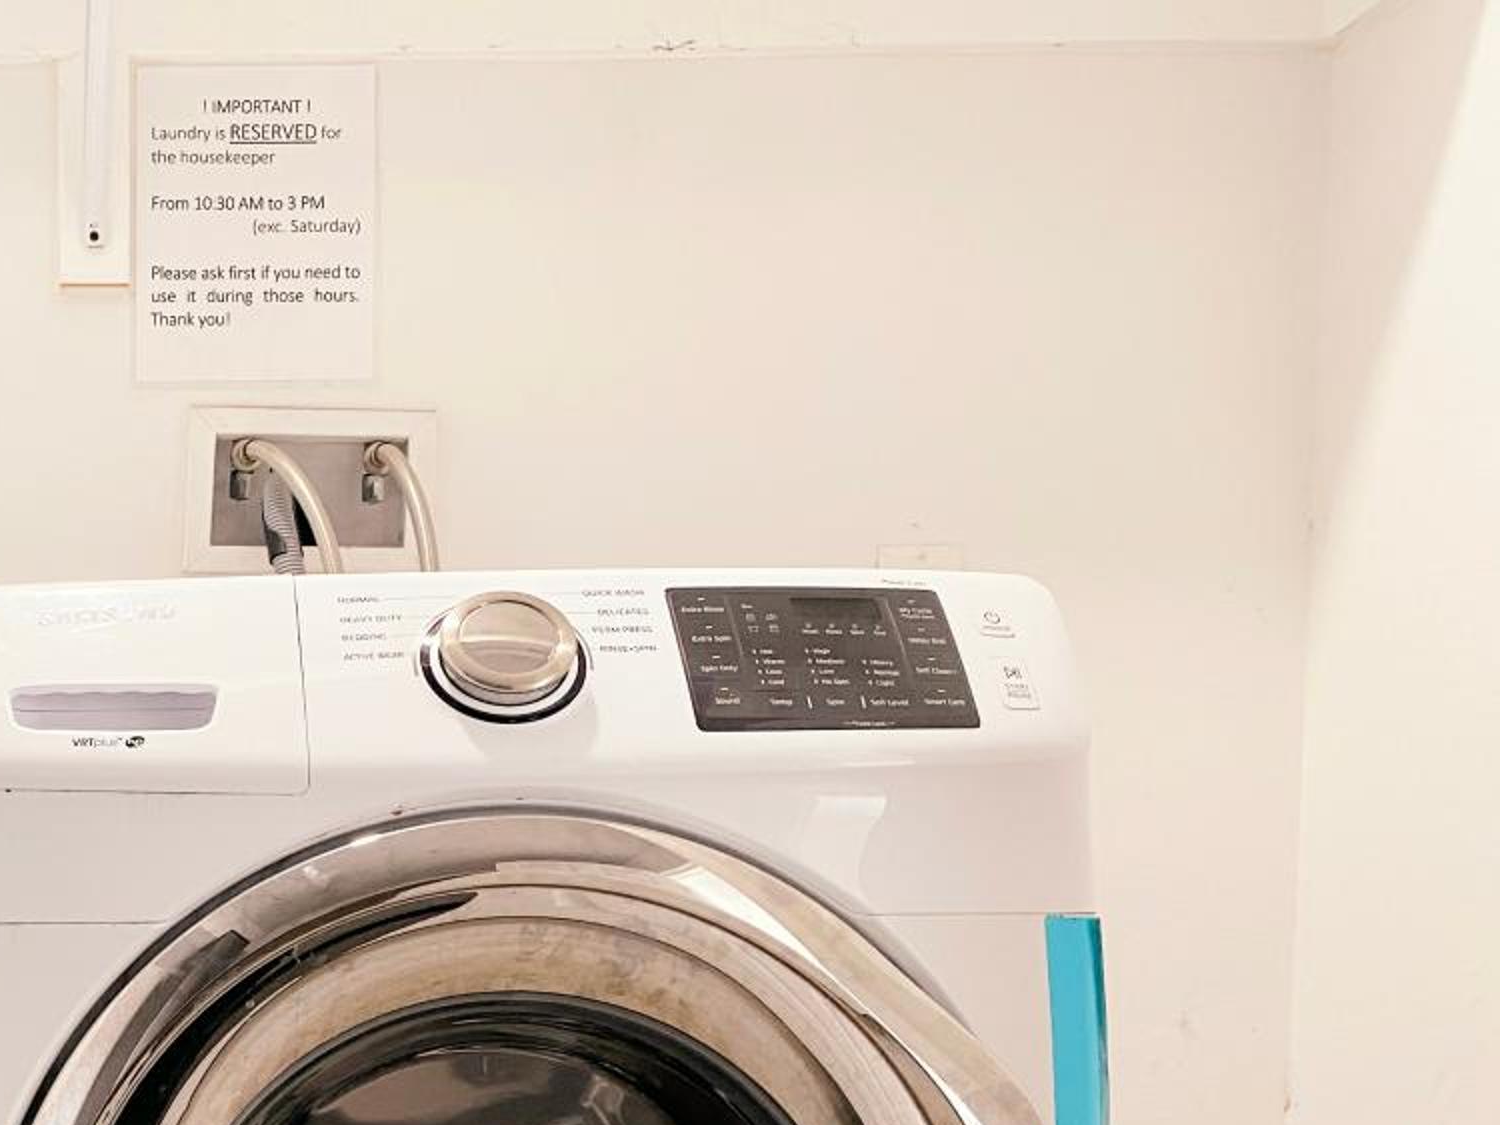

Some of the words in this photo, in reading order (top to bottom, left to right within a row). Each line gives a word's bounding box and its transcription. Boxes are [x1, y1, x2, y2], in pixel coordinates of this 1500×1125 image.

[211, 100, 302, 114] IMPORTANT
[151, 127, 211, 142] Laundry
[215, 127, 226, 140] is
[229, 124, 317, 144] RESERVED
[320, 126, 342, 140] for
[151, 151, 177, 165] the
[180, 150, 276, 167] housekeeper
[151, 197, 190, 211] From
[237, 197, 264, 211] AM
[267, 197, 284, 211] to
[287, 197, 297, 211] 3
[301, 197, 326, 211] PM
[252, 218, 284, 236] (exc.
[290, 219, 362, 236] Saturday)
[151, 266, 198, 281] Please
[201, 266, 223, 280] ask
[229, 265, 256, 280] first
[260, 265, 270, 280] if
[274, 269, 301, 284] you
[305, 265, 342, 280] need
[345, 267, 361, 280] to
[151, 291, 177, 304] use
[186, 289, 197, 303] it
[206, 288, 253, 306] during
[263, 288, 305, 303] those
[313, 288, 359, 304] hours.
[151, 312, 195, 327] Thank
[197, 312, 231, 331] you!
